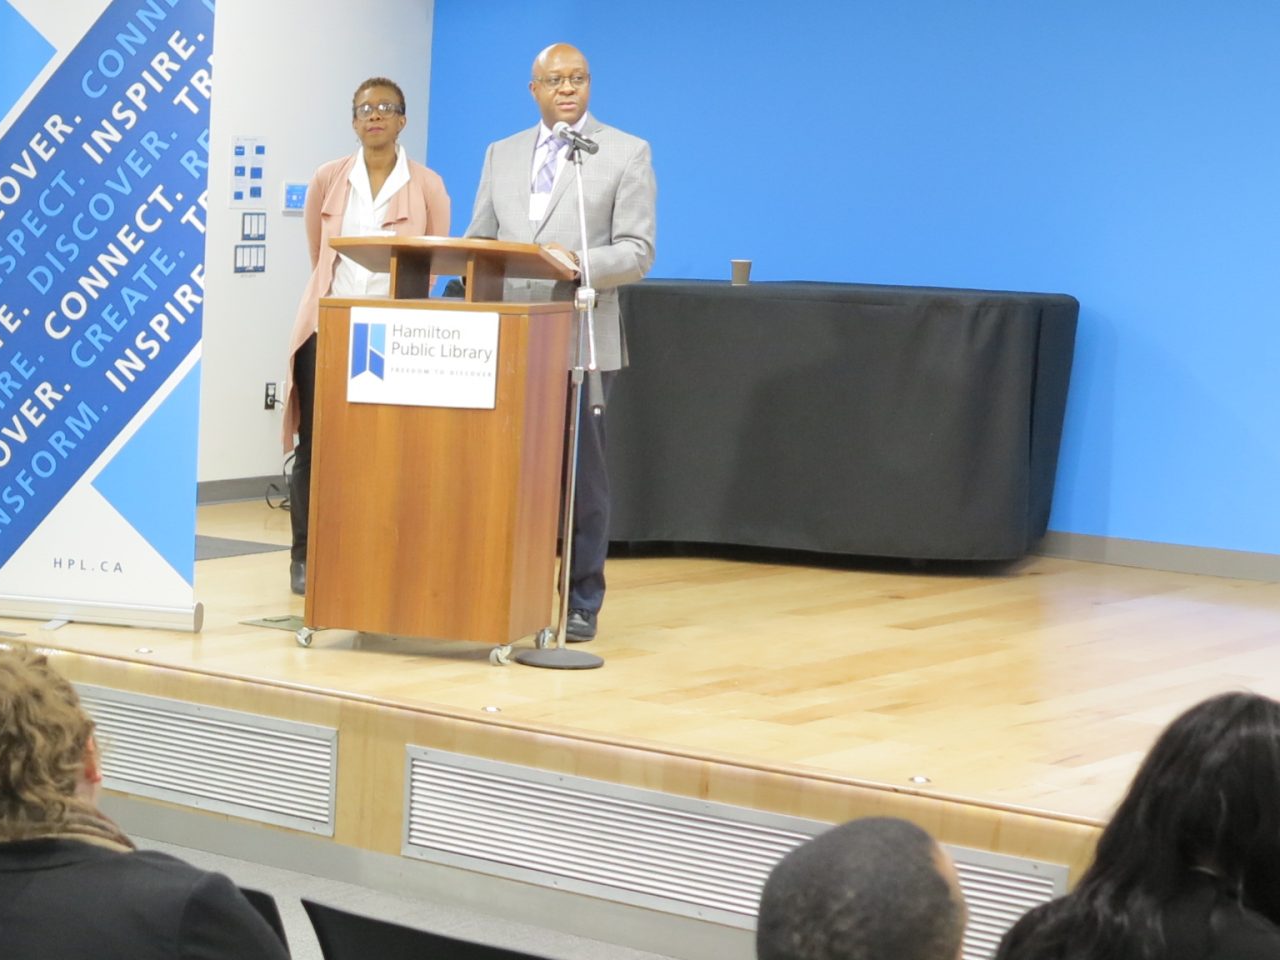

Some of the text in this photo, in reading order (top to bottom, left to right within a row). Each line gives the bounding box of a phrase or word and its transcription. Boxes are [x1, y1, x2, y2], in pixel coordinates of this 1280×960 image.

[81, 0, 181, 99] CONN
[82, 30, 205, 165] INSPIRE.
[26, 130, 178, 296] DISCOVER.
[172, 54, 214, 115] TR
[44, 184, 184, 340] CONNECT.
[71, 246, 186, 368] CREATE.
[391, 341, 493, 364] Public Library
[392, 323, 461, 340] Hamilton
[52, 556, 124, 574] HPL.CA
